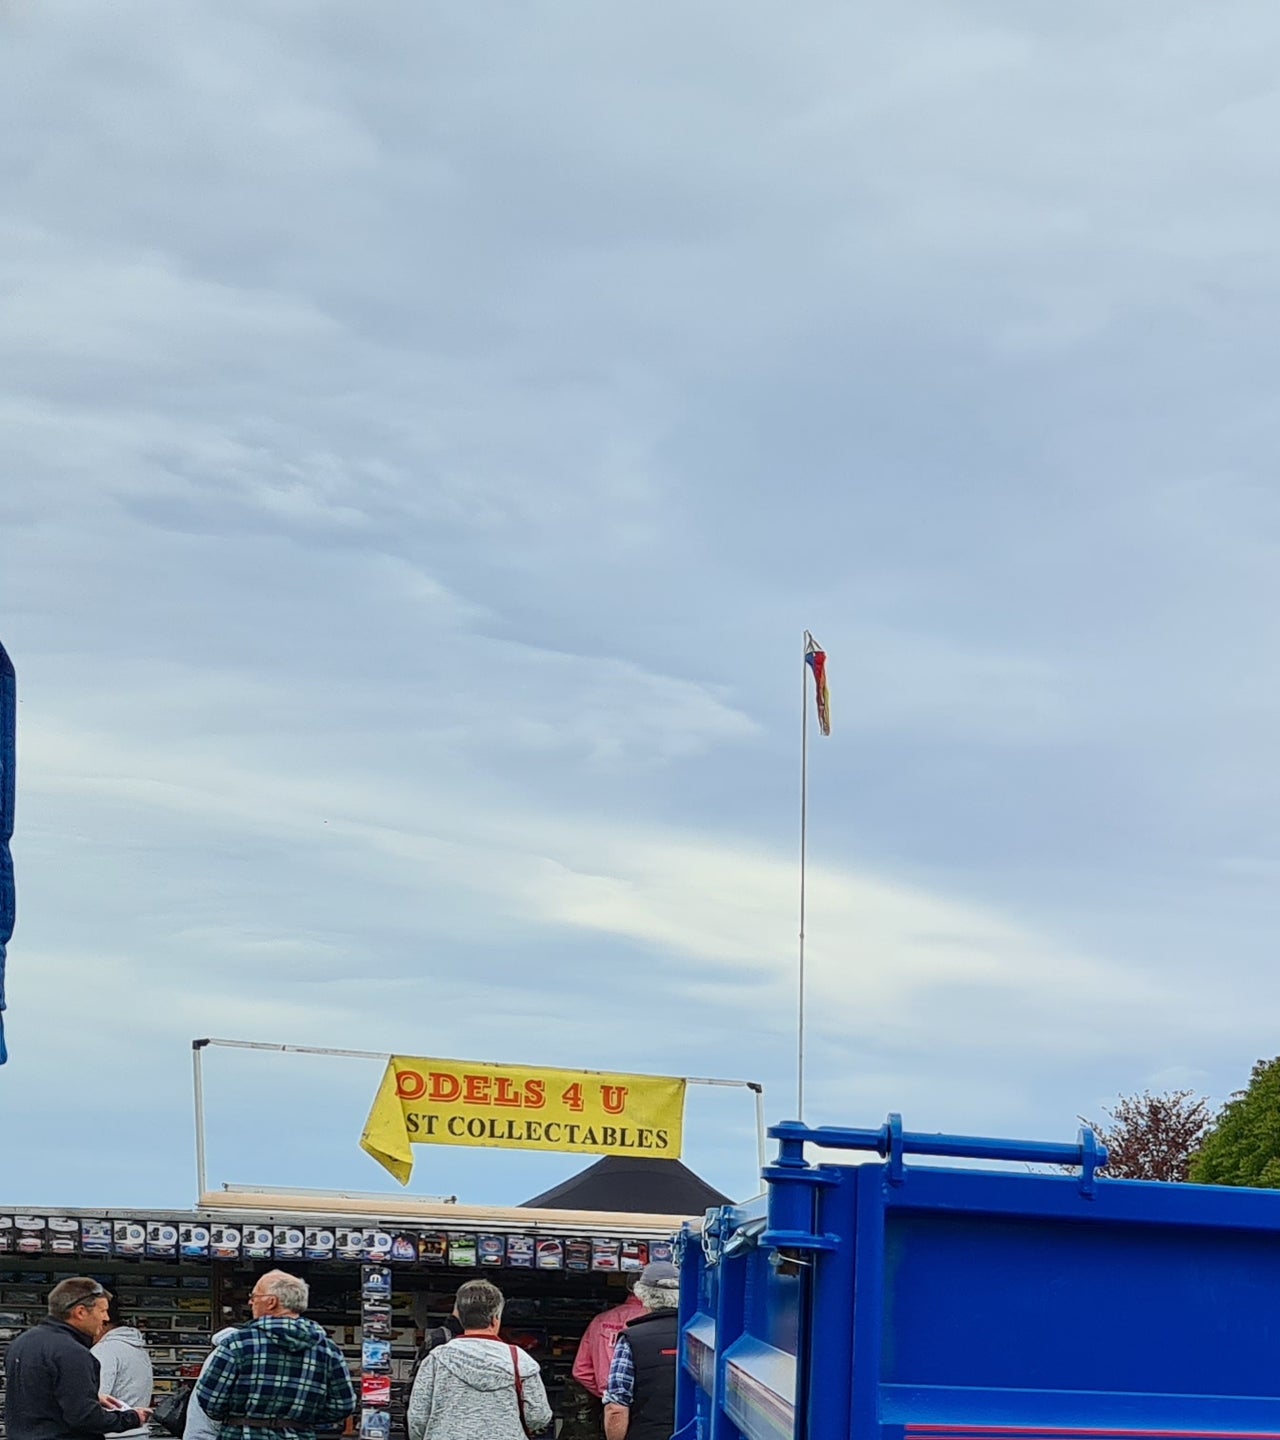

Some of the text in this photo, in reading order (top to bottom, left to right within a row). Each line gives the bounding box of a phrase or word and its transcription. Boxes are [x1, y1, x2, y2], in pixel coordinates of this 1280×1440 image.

[394, 1070, 629, 1115] ODELS 4 U
[406, 1112, 669, 1150] ST COLLECTABLES
